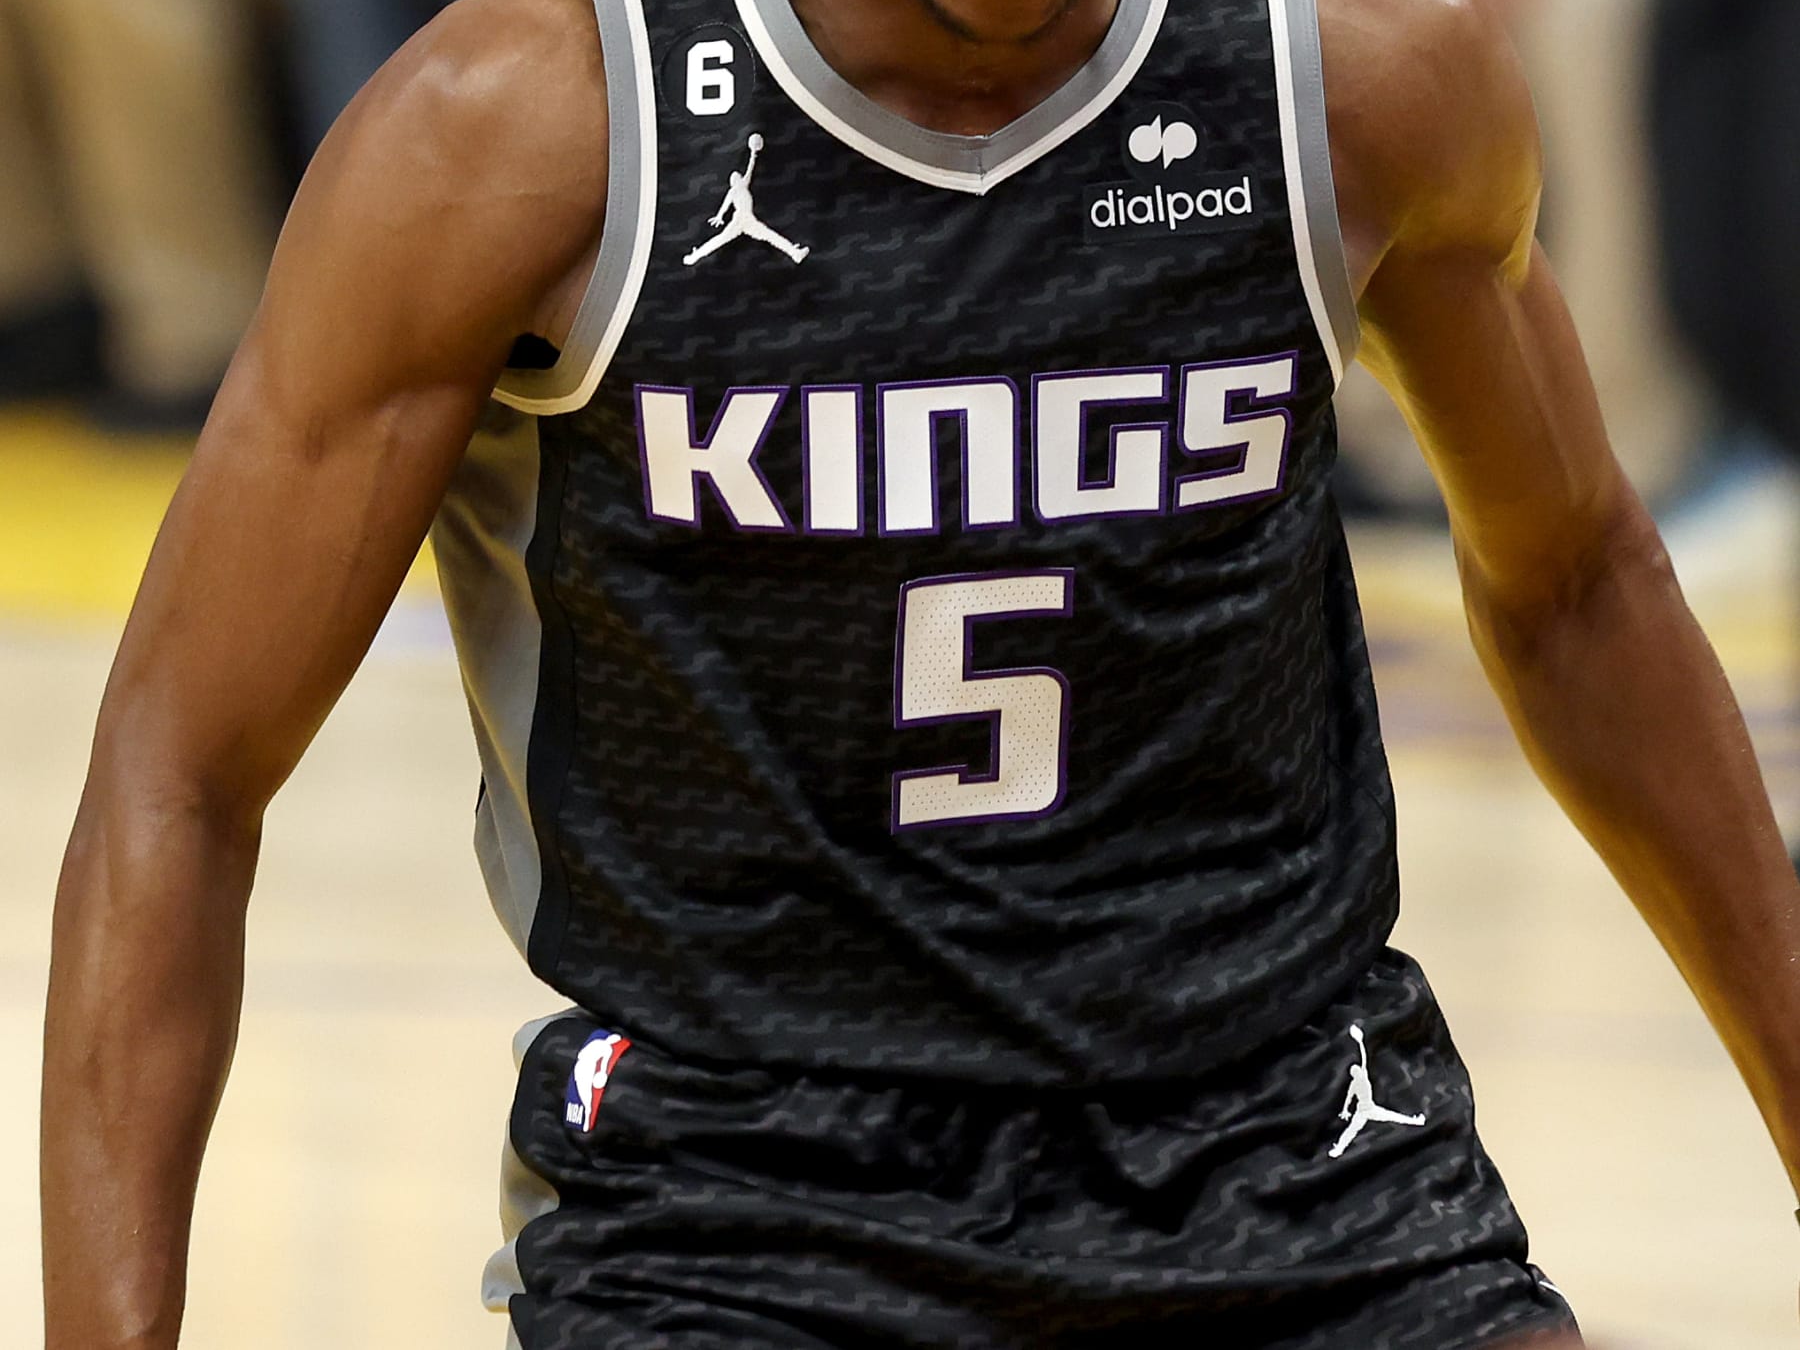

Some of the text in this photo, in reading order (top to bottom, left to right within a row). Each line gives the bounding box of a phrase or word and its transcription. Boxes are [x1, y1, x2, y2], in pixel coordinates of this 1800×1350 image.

[685, 40, 736, 116] 6
[1090, 177, 1252, 230] dialpad
[634, 350, 1298, 537] KINGS
[890, 567, 1075, 835] 5
[566, 1102, 584, 1125] NBA
